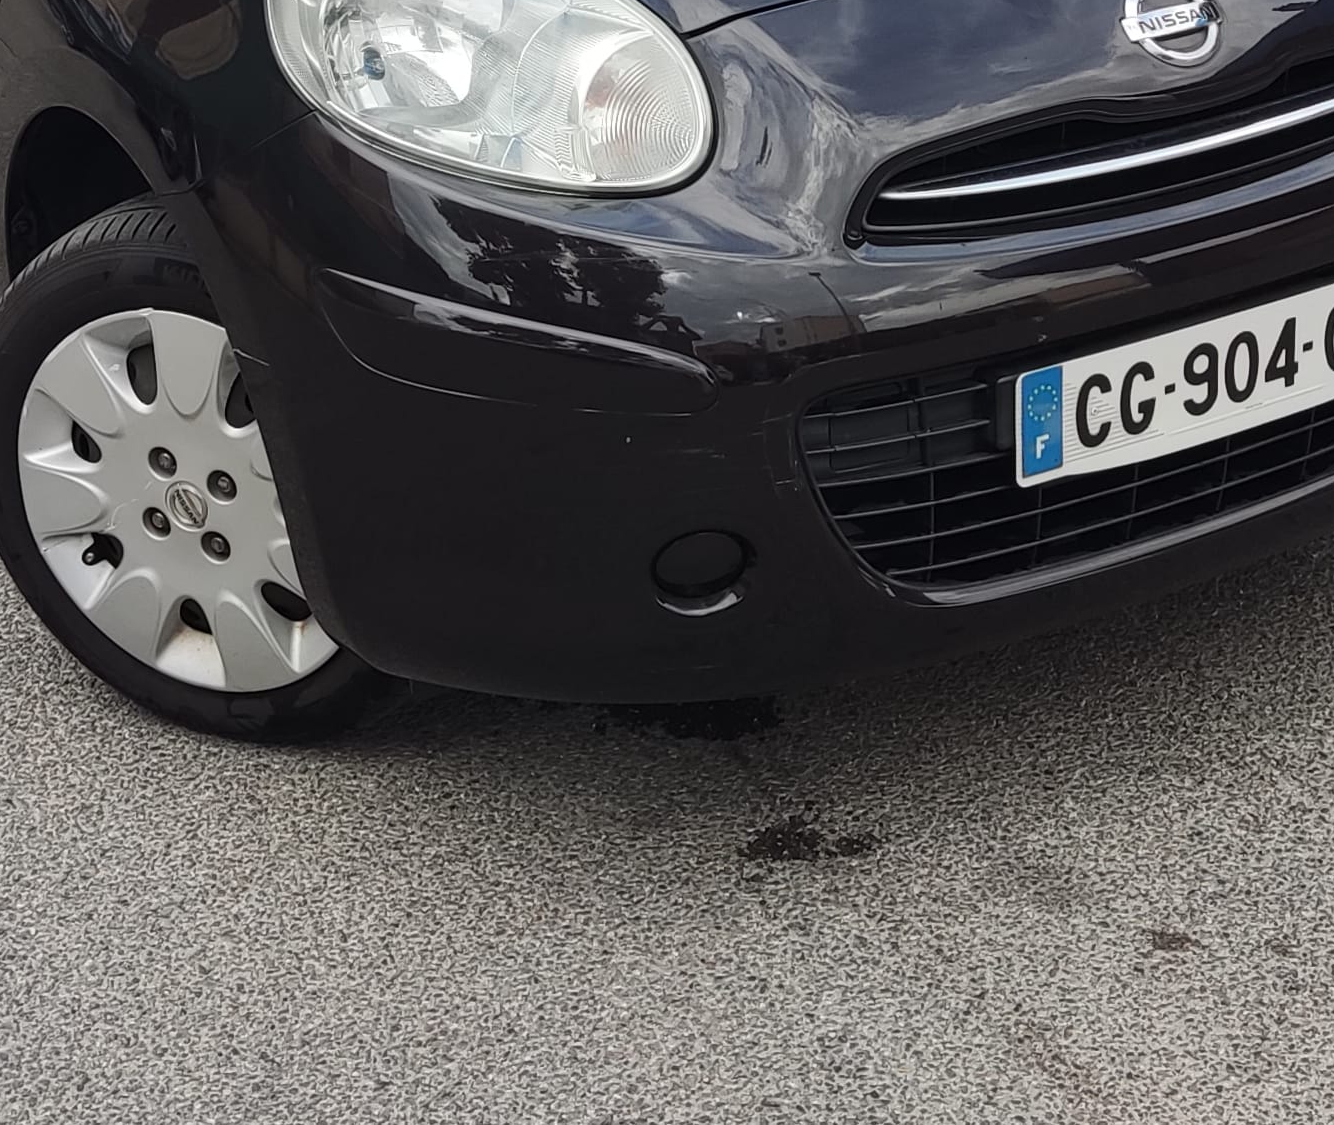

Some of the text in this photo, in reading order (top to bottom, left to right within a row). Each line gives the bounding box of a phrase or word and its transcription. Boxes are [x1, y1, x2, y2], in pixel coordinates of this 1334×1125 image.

[1138, 2, 1219, 34] NISSAN
[1035, 433, 1051, 460] F
[174, 489, 200, 525] NISSAN
